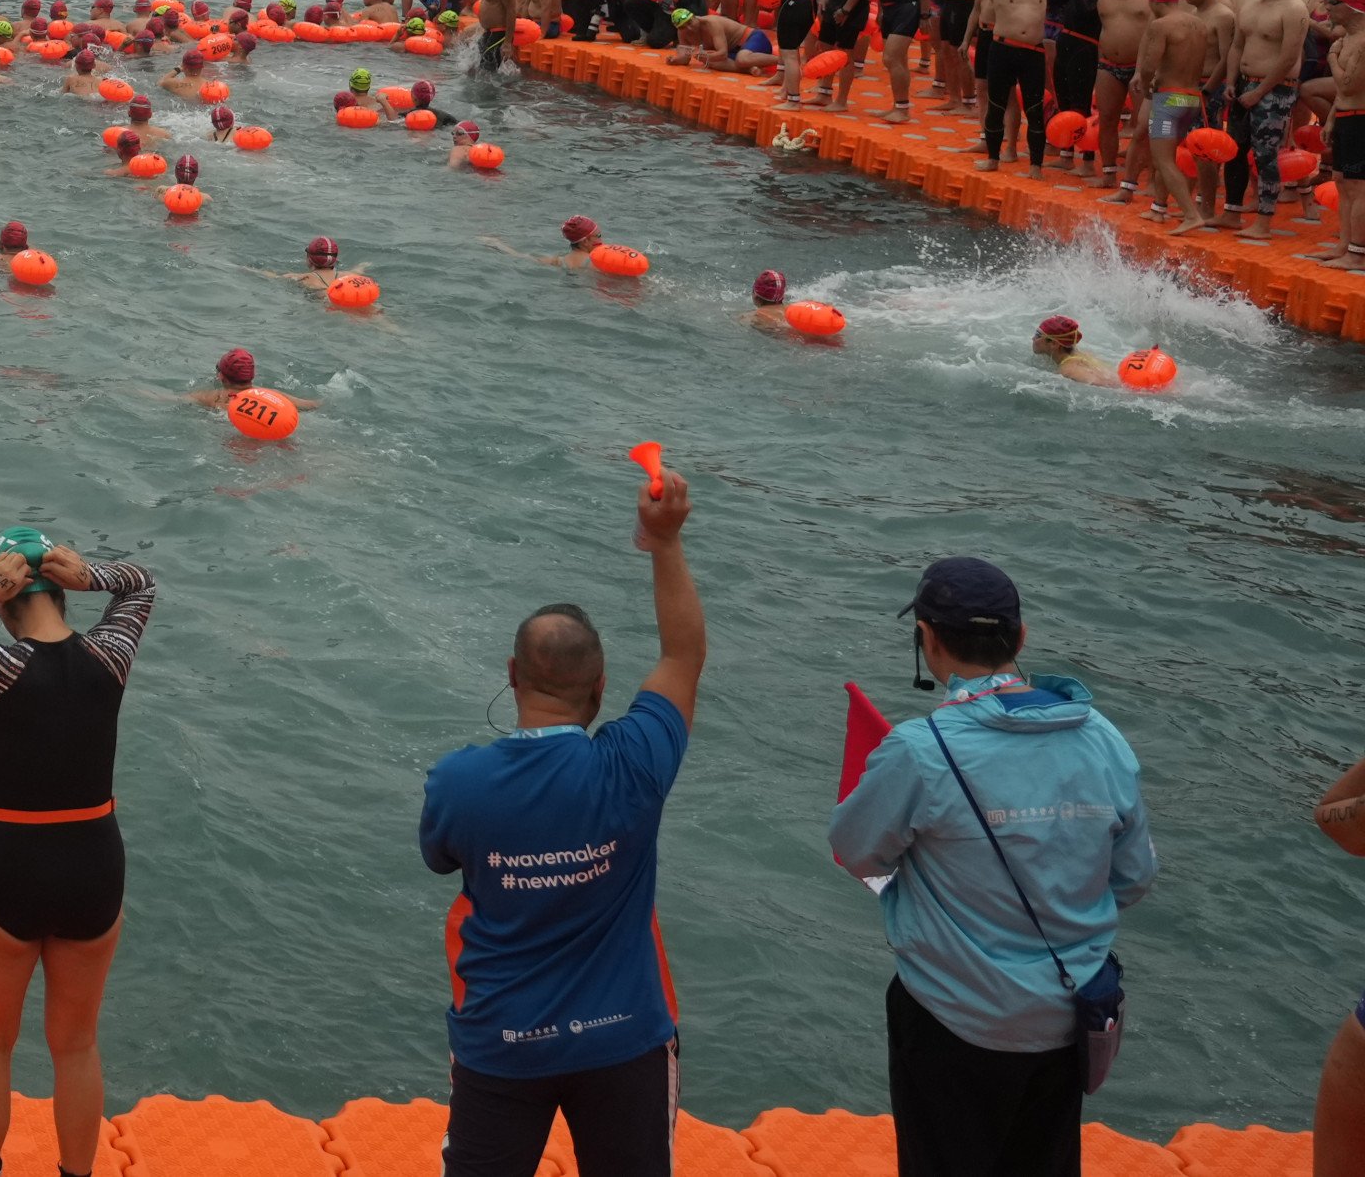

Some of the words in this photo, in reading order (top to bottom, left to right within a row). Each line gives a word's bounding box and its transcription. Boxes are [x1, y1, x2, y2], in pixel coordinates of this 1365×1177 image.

[211, 42, 232, 55] 2086
[236, 397, 278, 426] 2211
[487, 840, 617, 868] #wavemaker
[501, 859, 610, 890] #newworld
